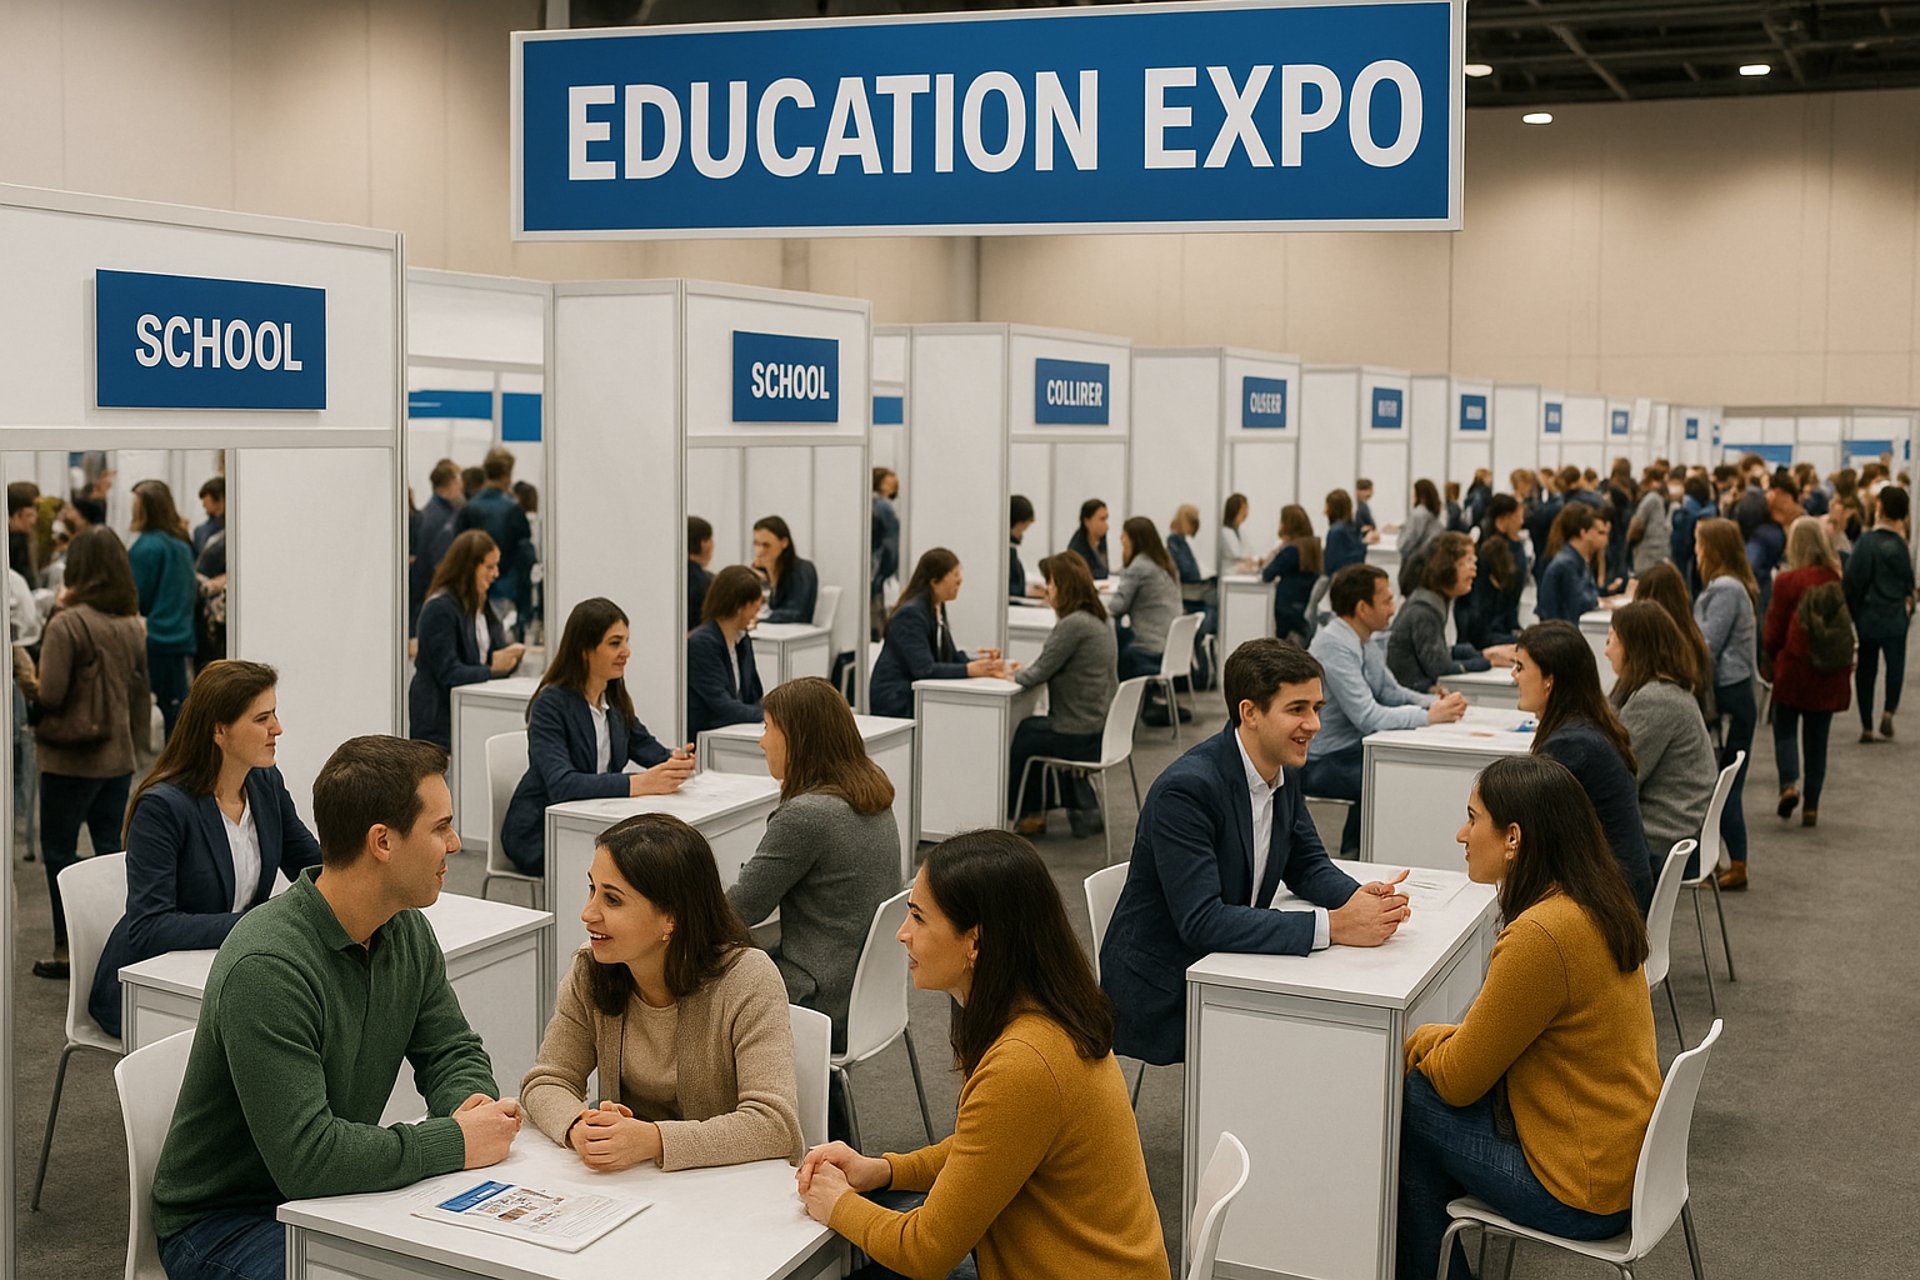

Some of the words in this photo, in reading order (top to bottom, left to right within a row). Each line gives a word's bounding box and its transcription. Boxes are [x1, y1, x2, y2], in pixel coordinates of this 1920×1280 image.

[568, 69, 1099, 182] EDUCATION
[1144, 59, 1424, 171] EXPO
[134, 313, 303, 372] SCHOOL
[750, 361, 831, 402] SCHOOL
